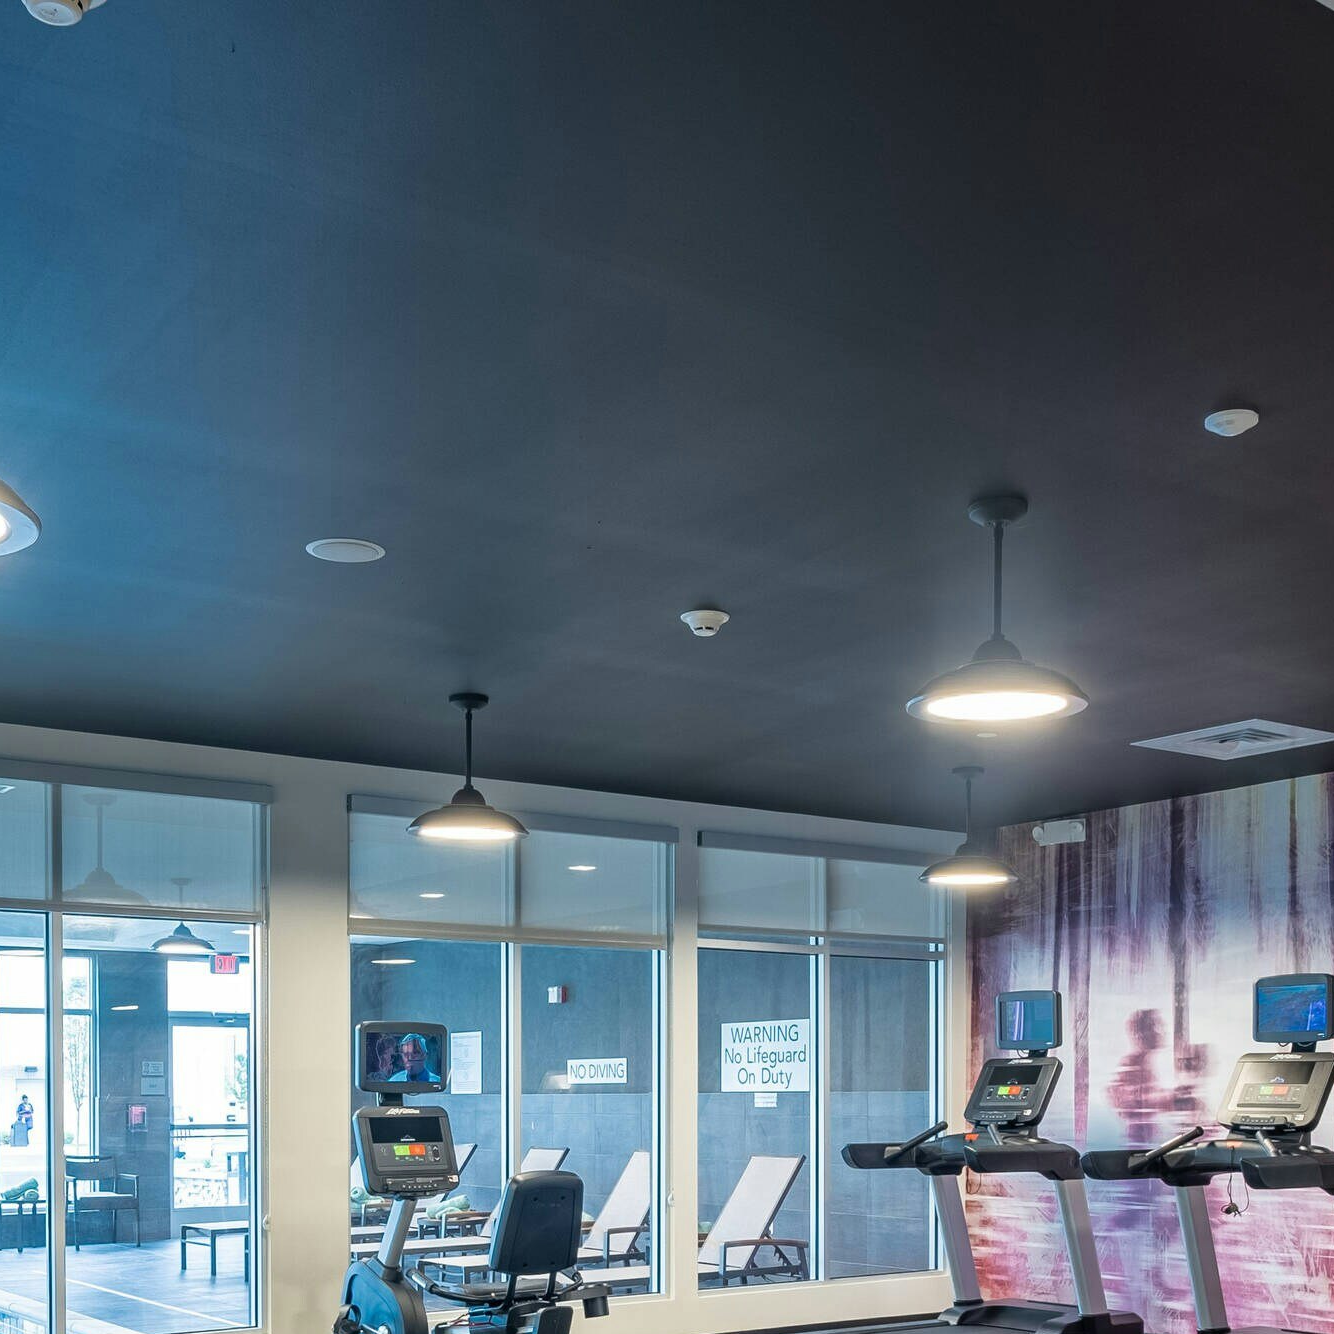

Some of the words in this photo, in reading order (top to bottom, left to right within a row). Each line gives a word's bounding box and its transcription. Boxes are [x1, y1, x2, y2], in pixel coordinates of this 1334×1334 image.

[730, 1024, 799, 1044] WARNING
[724, 1048, 742, 1064] No
[746, 1044, 807, 1068] Lifeguard
[570, 1064, 587, 1079] NO
[588, 1063, 625, 1079] DIVING
[737, 1067, 756, 1084] On
[761, 1067, 793, 1089] Duty
